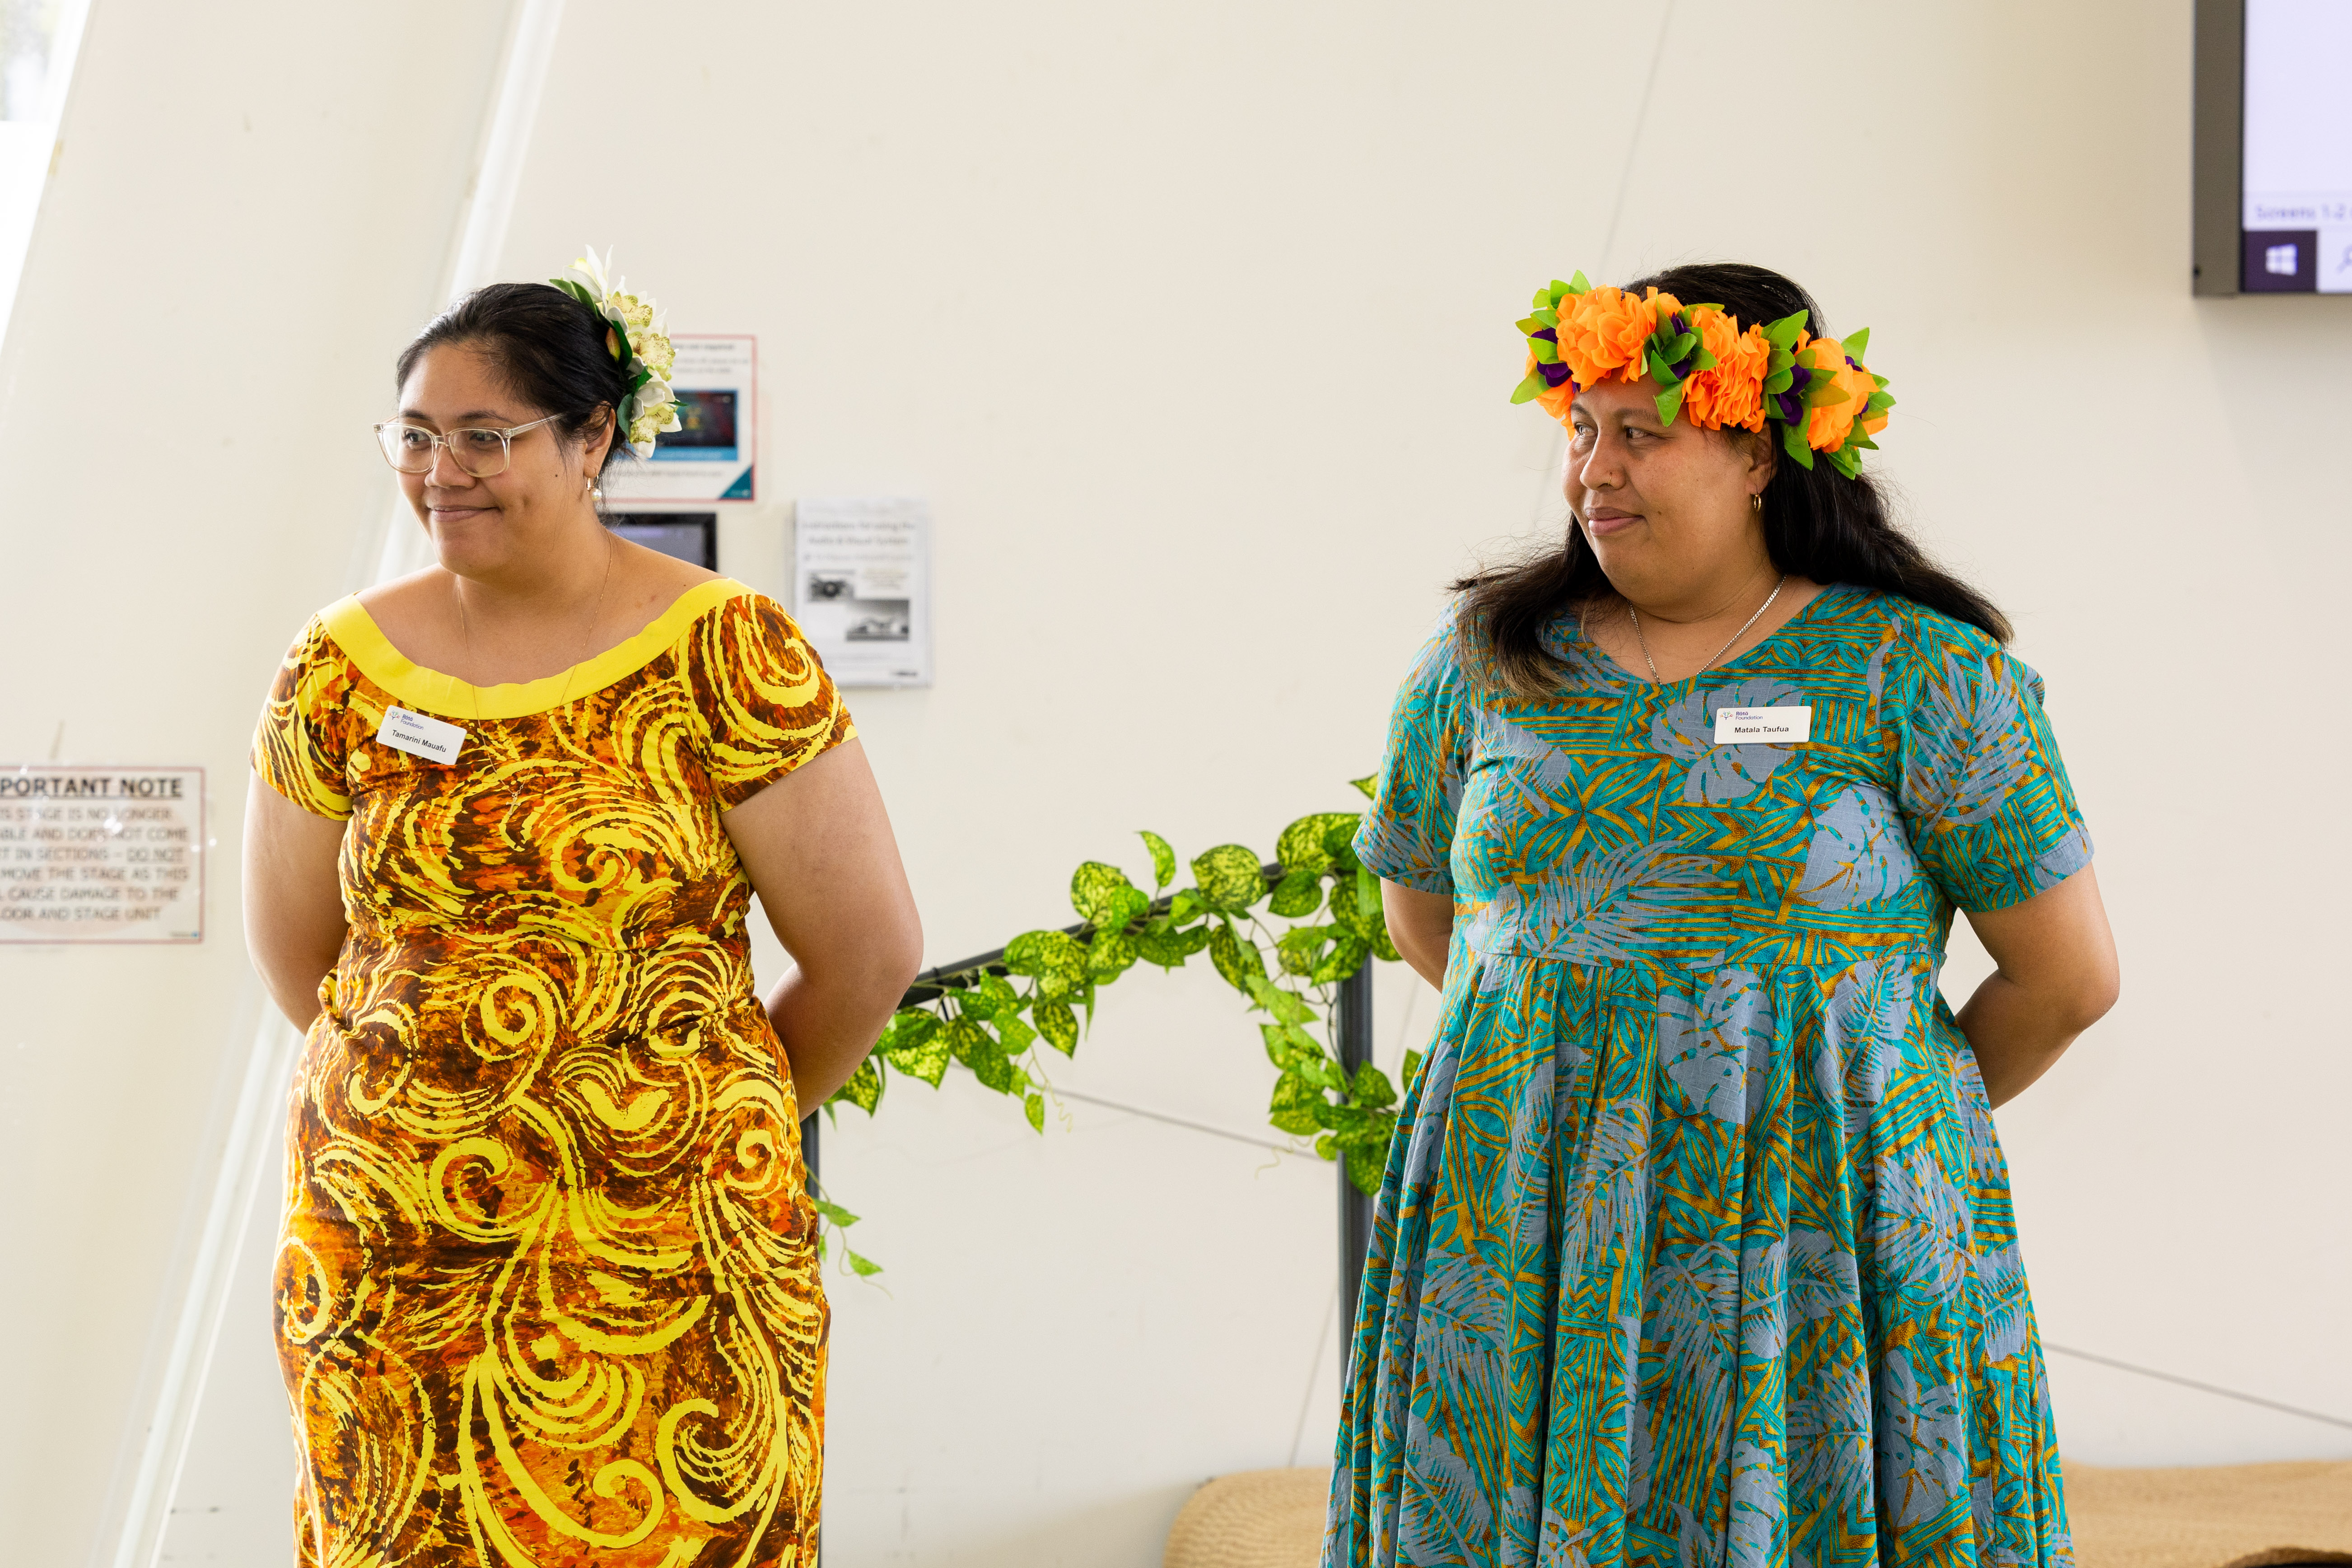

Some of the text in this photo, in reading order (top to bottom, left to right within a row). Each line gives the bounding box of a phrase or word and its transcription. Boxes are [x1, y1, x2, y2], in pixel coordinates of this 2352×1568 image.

[401, 719, 424, 730] Foundation
[392, 730, 447, 752] Tamarini Mauafu
[0, 777, 183, 797] PORTANT NOTE
[17, 808, 62, 821] STAGE
[68, 808, 82, 821] IS
[88, 808, 109, 821] NO
[33, 827, 63, 841] AND
[68, 827, 108, 841] DOES
[146, 827, 189, 841] COME
[15, 847, 32, 861] IN
[37, 847, 108, 861] SECTIONS
[126, 847, 149, 861] DO
[154, 847, 183, 861] NOT
[1, 867, 189, 881] MOVE THE STAGE AS THIS
[8, 887, 55, 901] CAUSE
[60, 887, 120, 901] DAMAGE
[127, 887, 147, 901] TO
[153, 887, 179, 901] THE
[39, 907, 70, 921] AND
[75, 907, 120, 921] STAGE
[125, 907, 161, 921] UNIT
